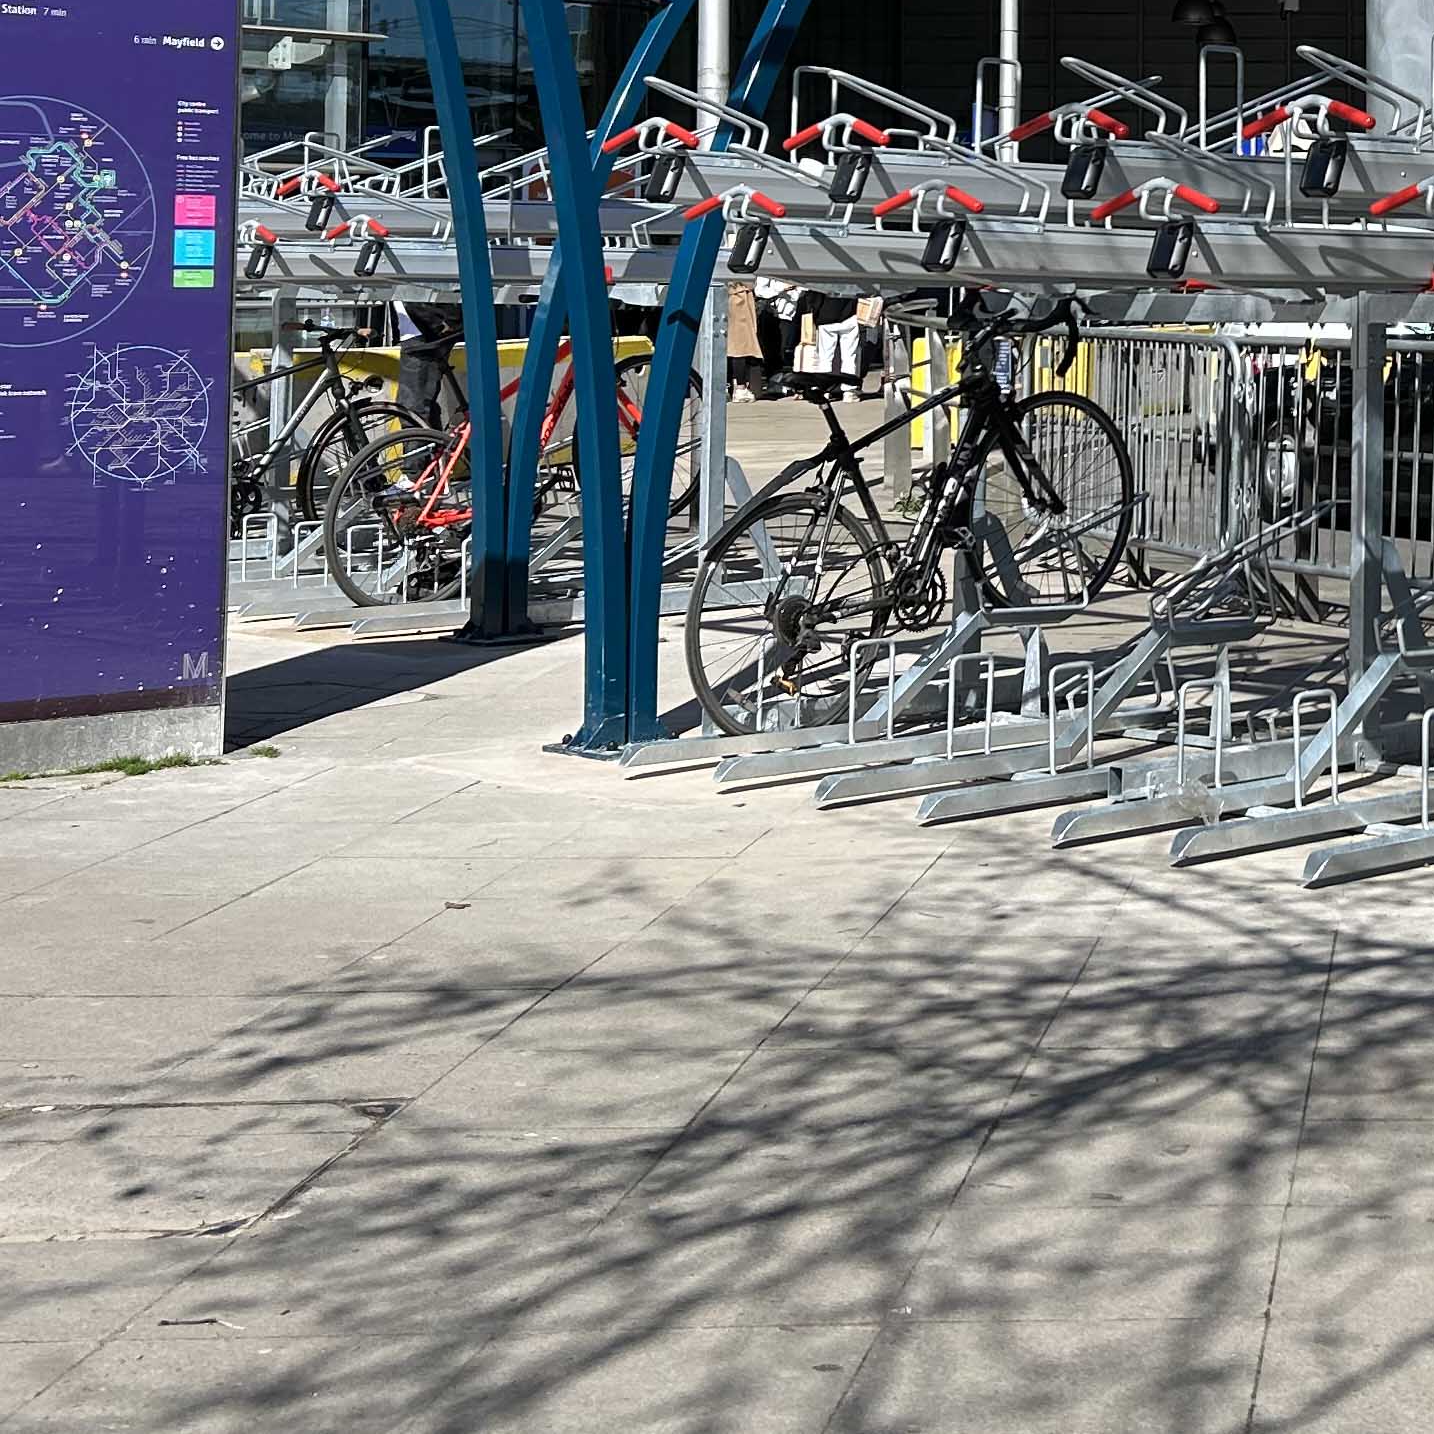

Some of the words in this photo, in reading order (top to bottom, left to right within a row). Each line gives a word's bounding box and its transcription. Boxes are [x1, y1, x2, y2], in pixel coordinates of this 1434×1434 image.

[1, 3, 37, 15] Station
[43, 7, 49, 16] 7
[50, 8, 67, 17] min
[162, 36, 205, 49] Mayfield
[183, 652, 208, 679] M
